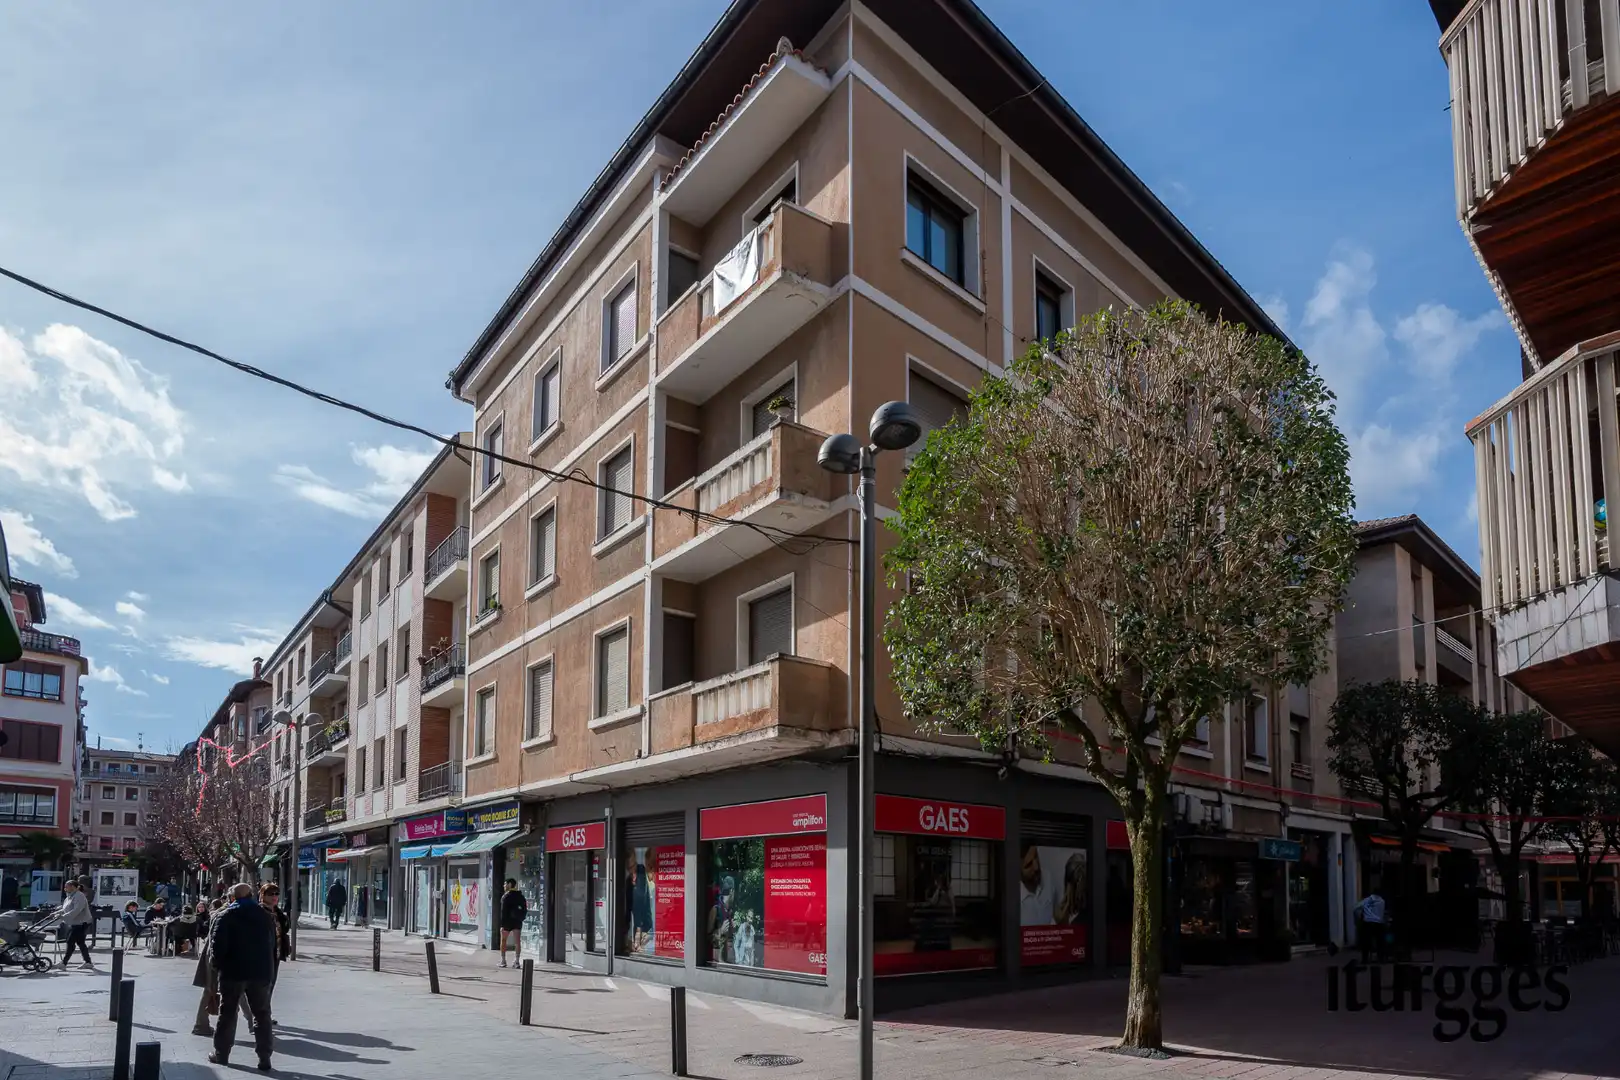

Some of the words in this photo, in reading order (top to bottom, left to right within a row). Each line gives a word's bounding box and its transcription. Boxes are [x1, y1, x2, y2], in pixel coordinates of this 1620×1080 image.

[792, 814, 824, 829] amplifon
[918, 804, 970, 833] GAES
[562, 827, 586, 848] GAES
